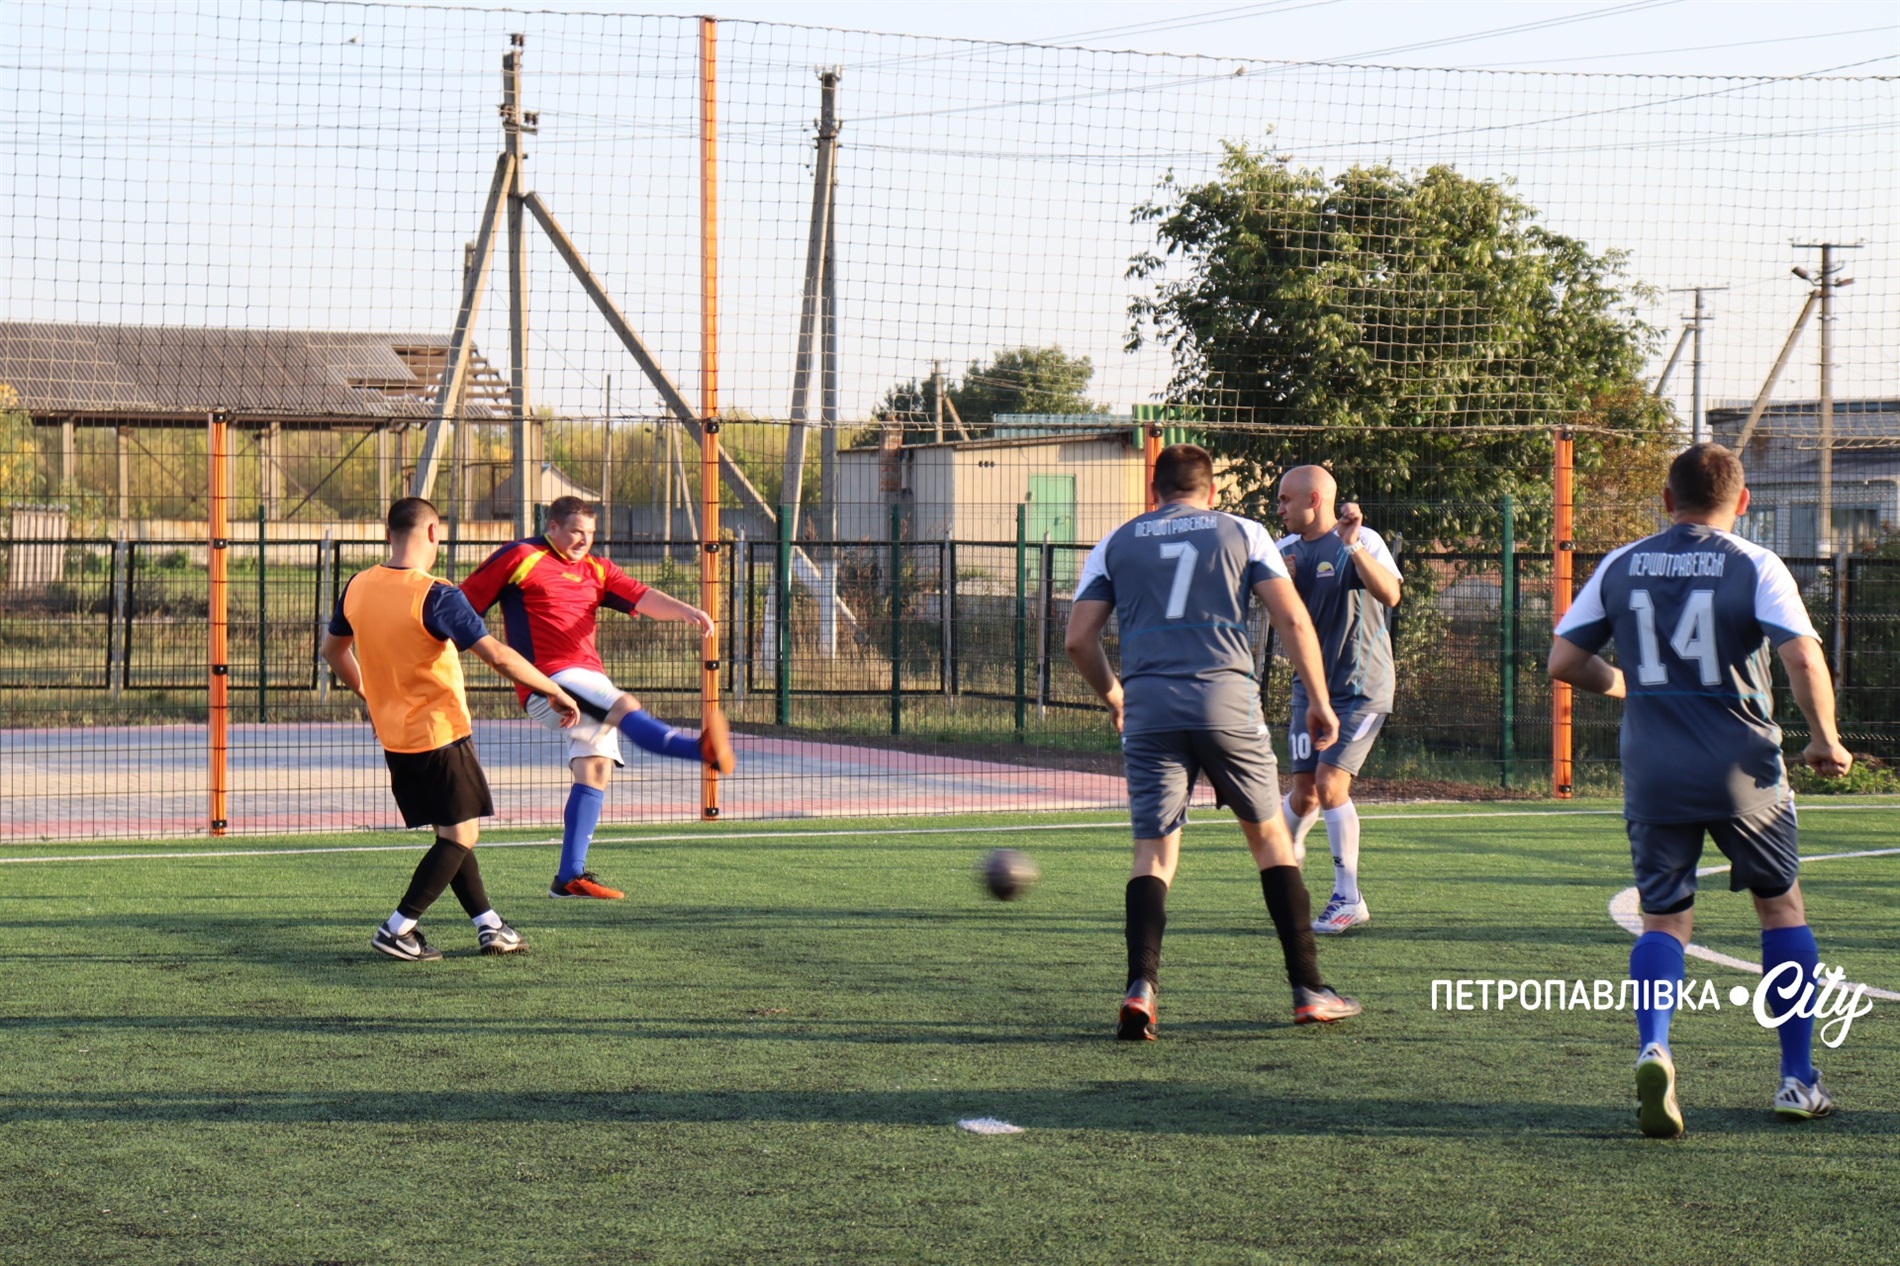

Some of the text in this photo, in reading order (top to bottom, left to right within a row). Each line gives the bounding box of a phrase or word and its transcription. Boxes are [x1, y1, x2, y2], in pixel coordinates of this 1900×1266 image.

[1159, 541, 1199, 619] 7
[1629, 552, 1726, 577] ПЕРШОТРАВЕНСЬК
[1629, 589, 1722, 686] 14
[1291, 732, 1311, 760] 10
